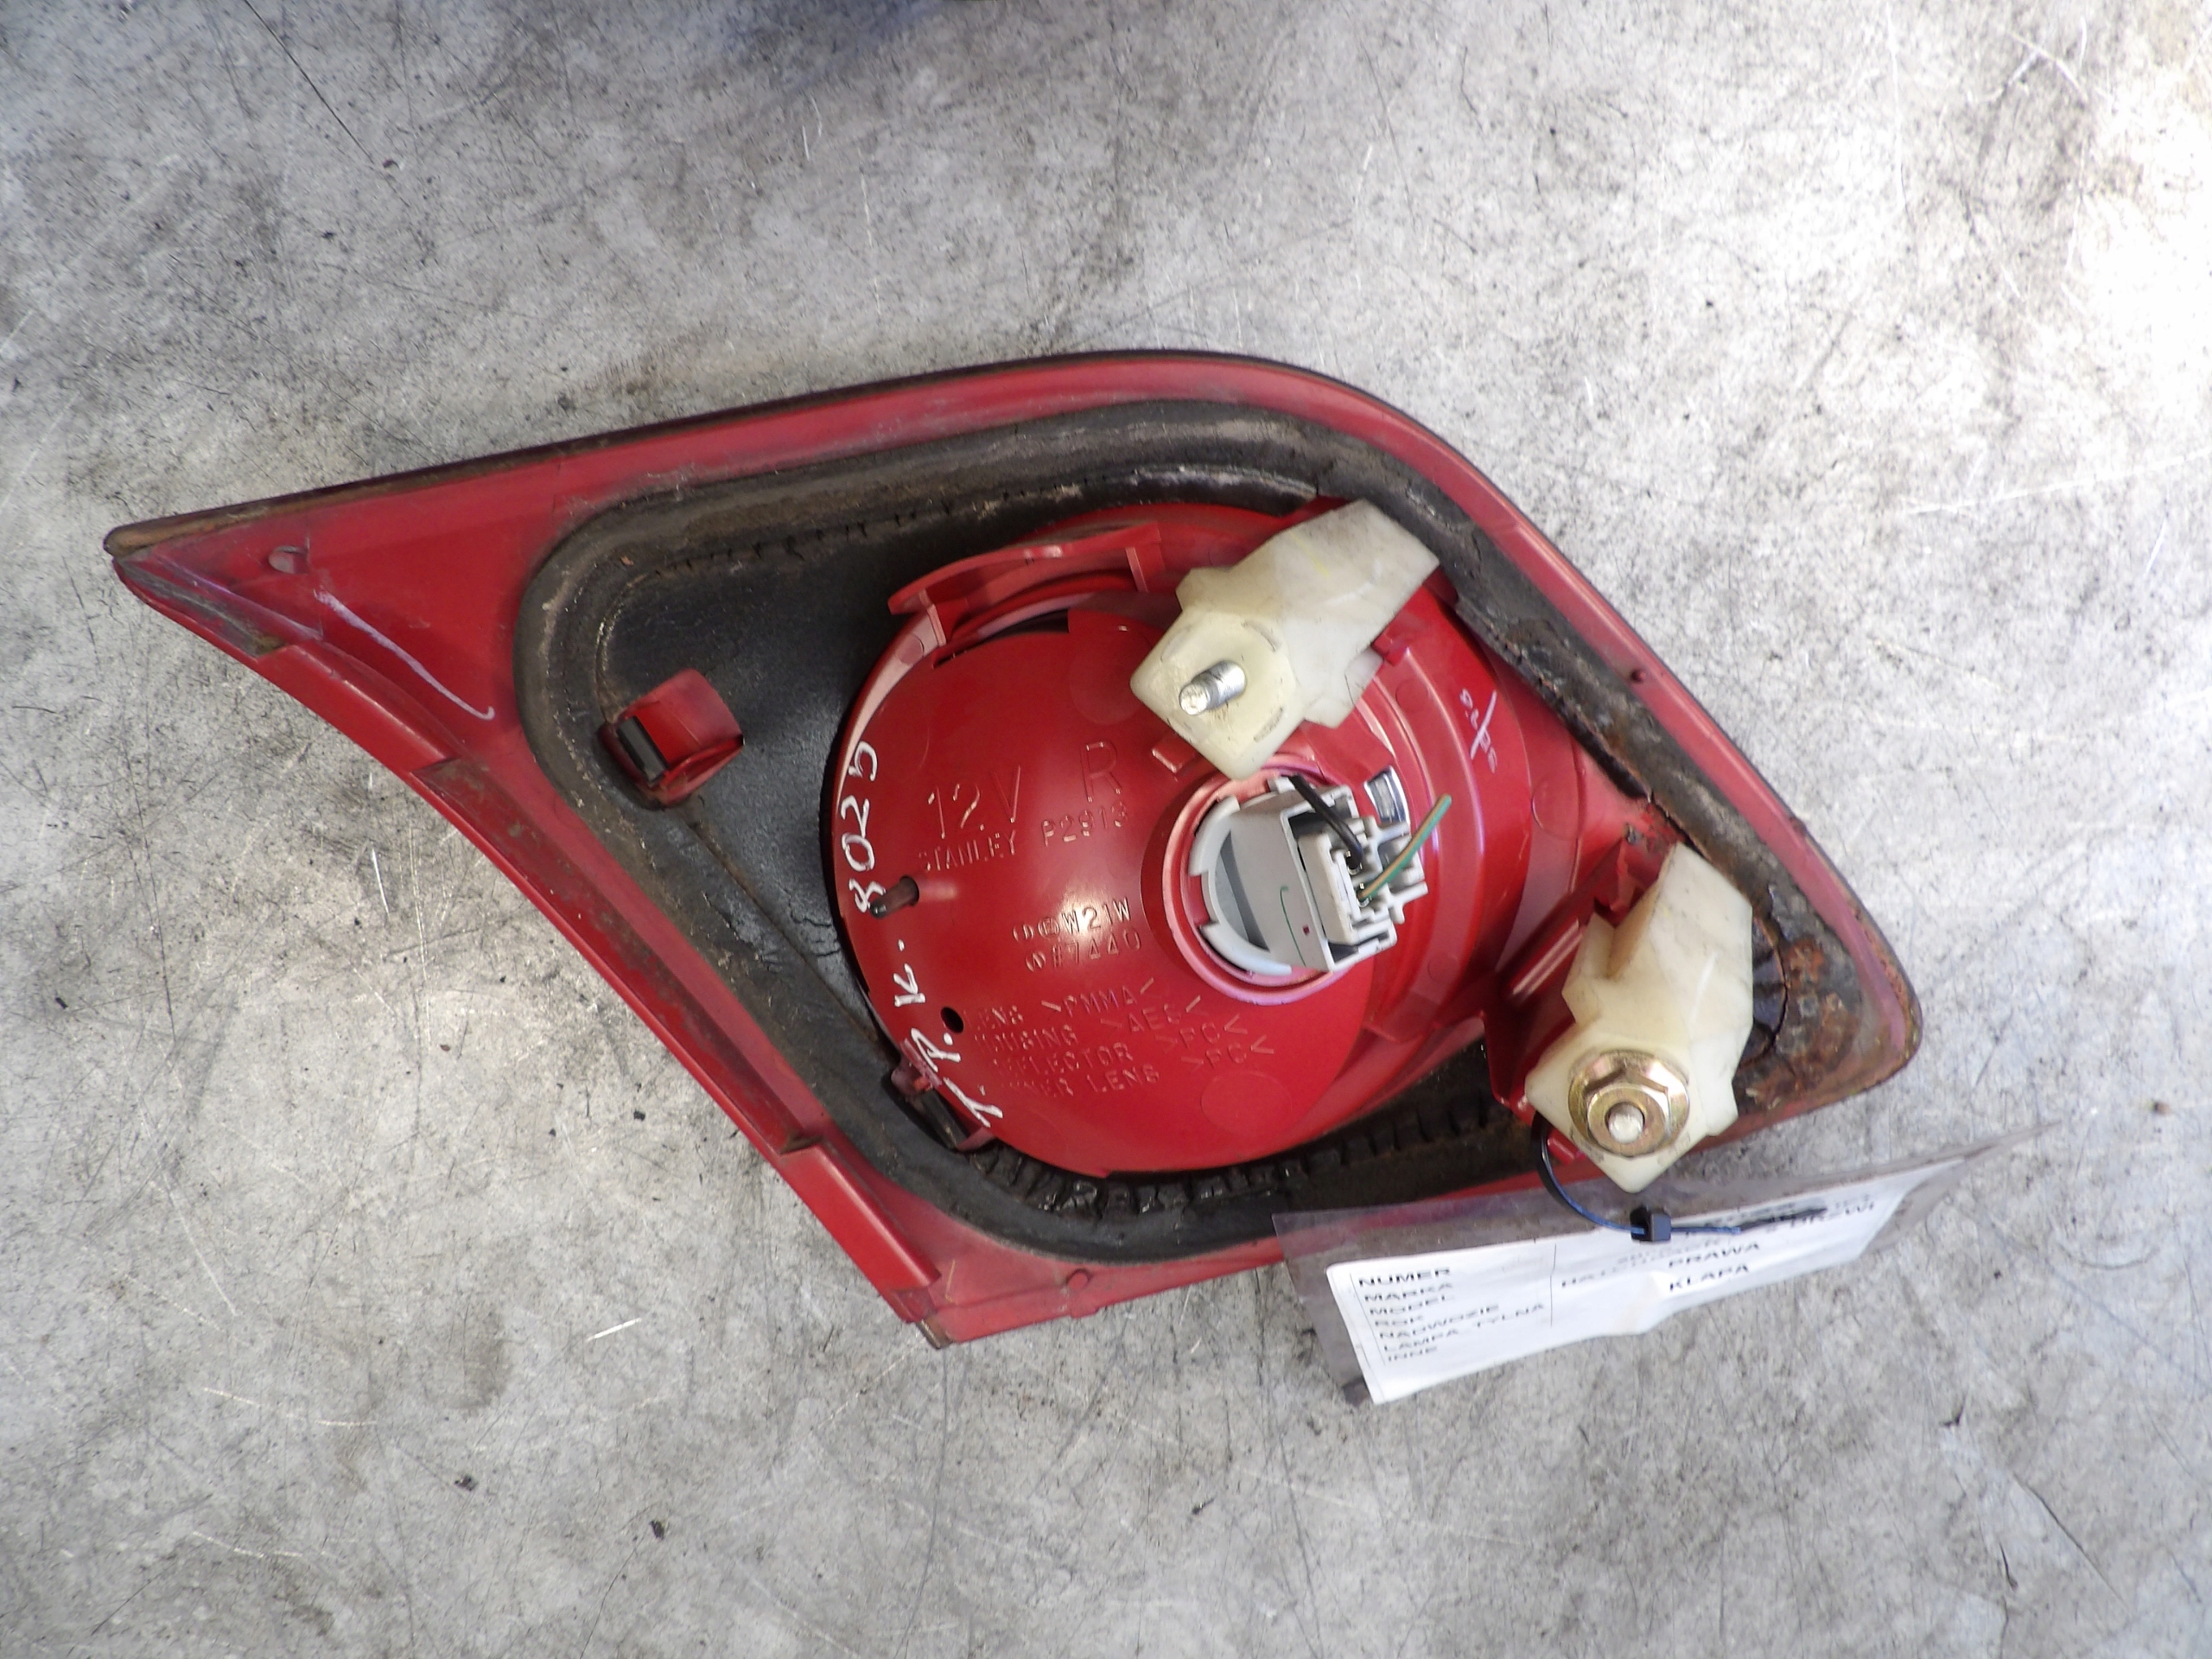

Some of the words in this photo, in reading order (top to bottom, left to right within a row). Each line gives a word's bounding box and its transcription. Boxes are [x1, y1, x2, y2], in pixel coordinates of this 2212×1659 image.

[1081, 741, 1122, 804] R
[918, 830, 1017, 871] STANLEY
[1669, 1243, 1760, 1268] PRAWA
[1359, 1267, 1450, 1287] NUMER
[1364, 1283, 1452, 1302] MARKA
